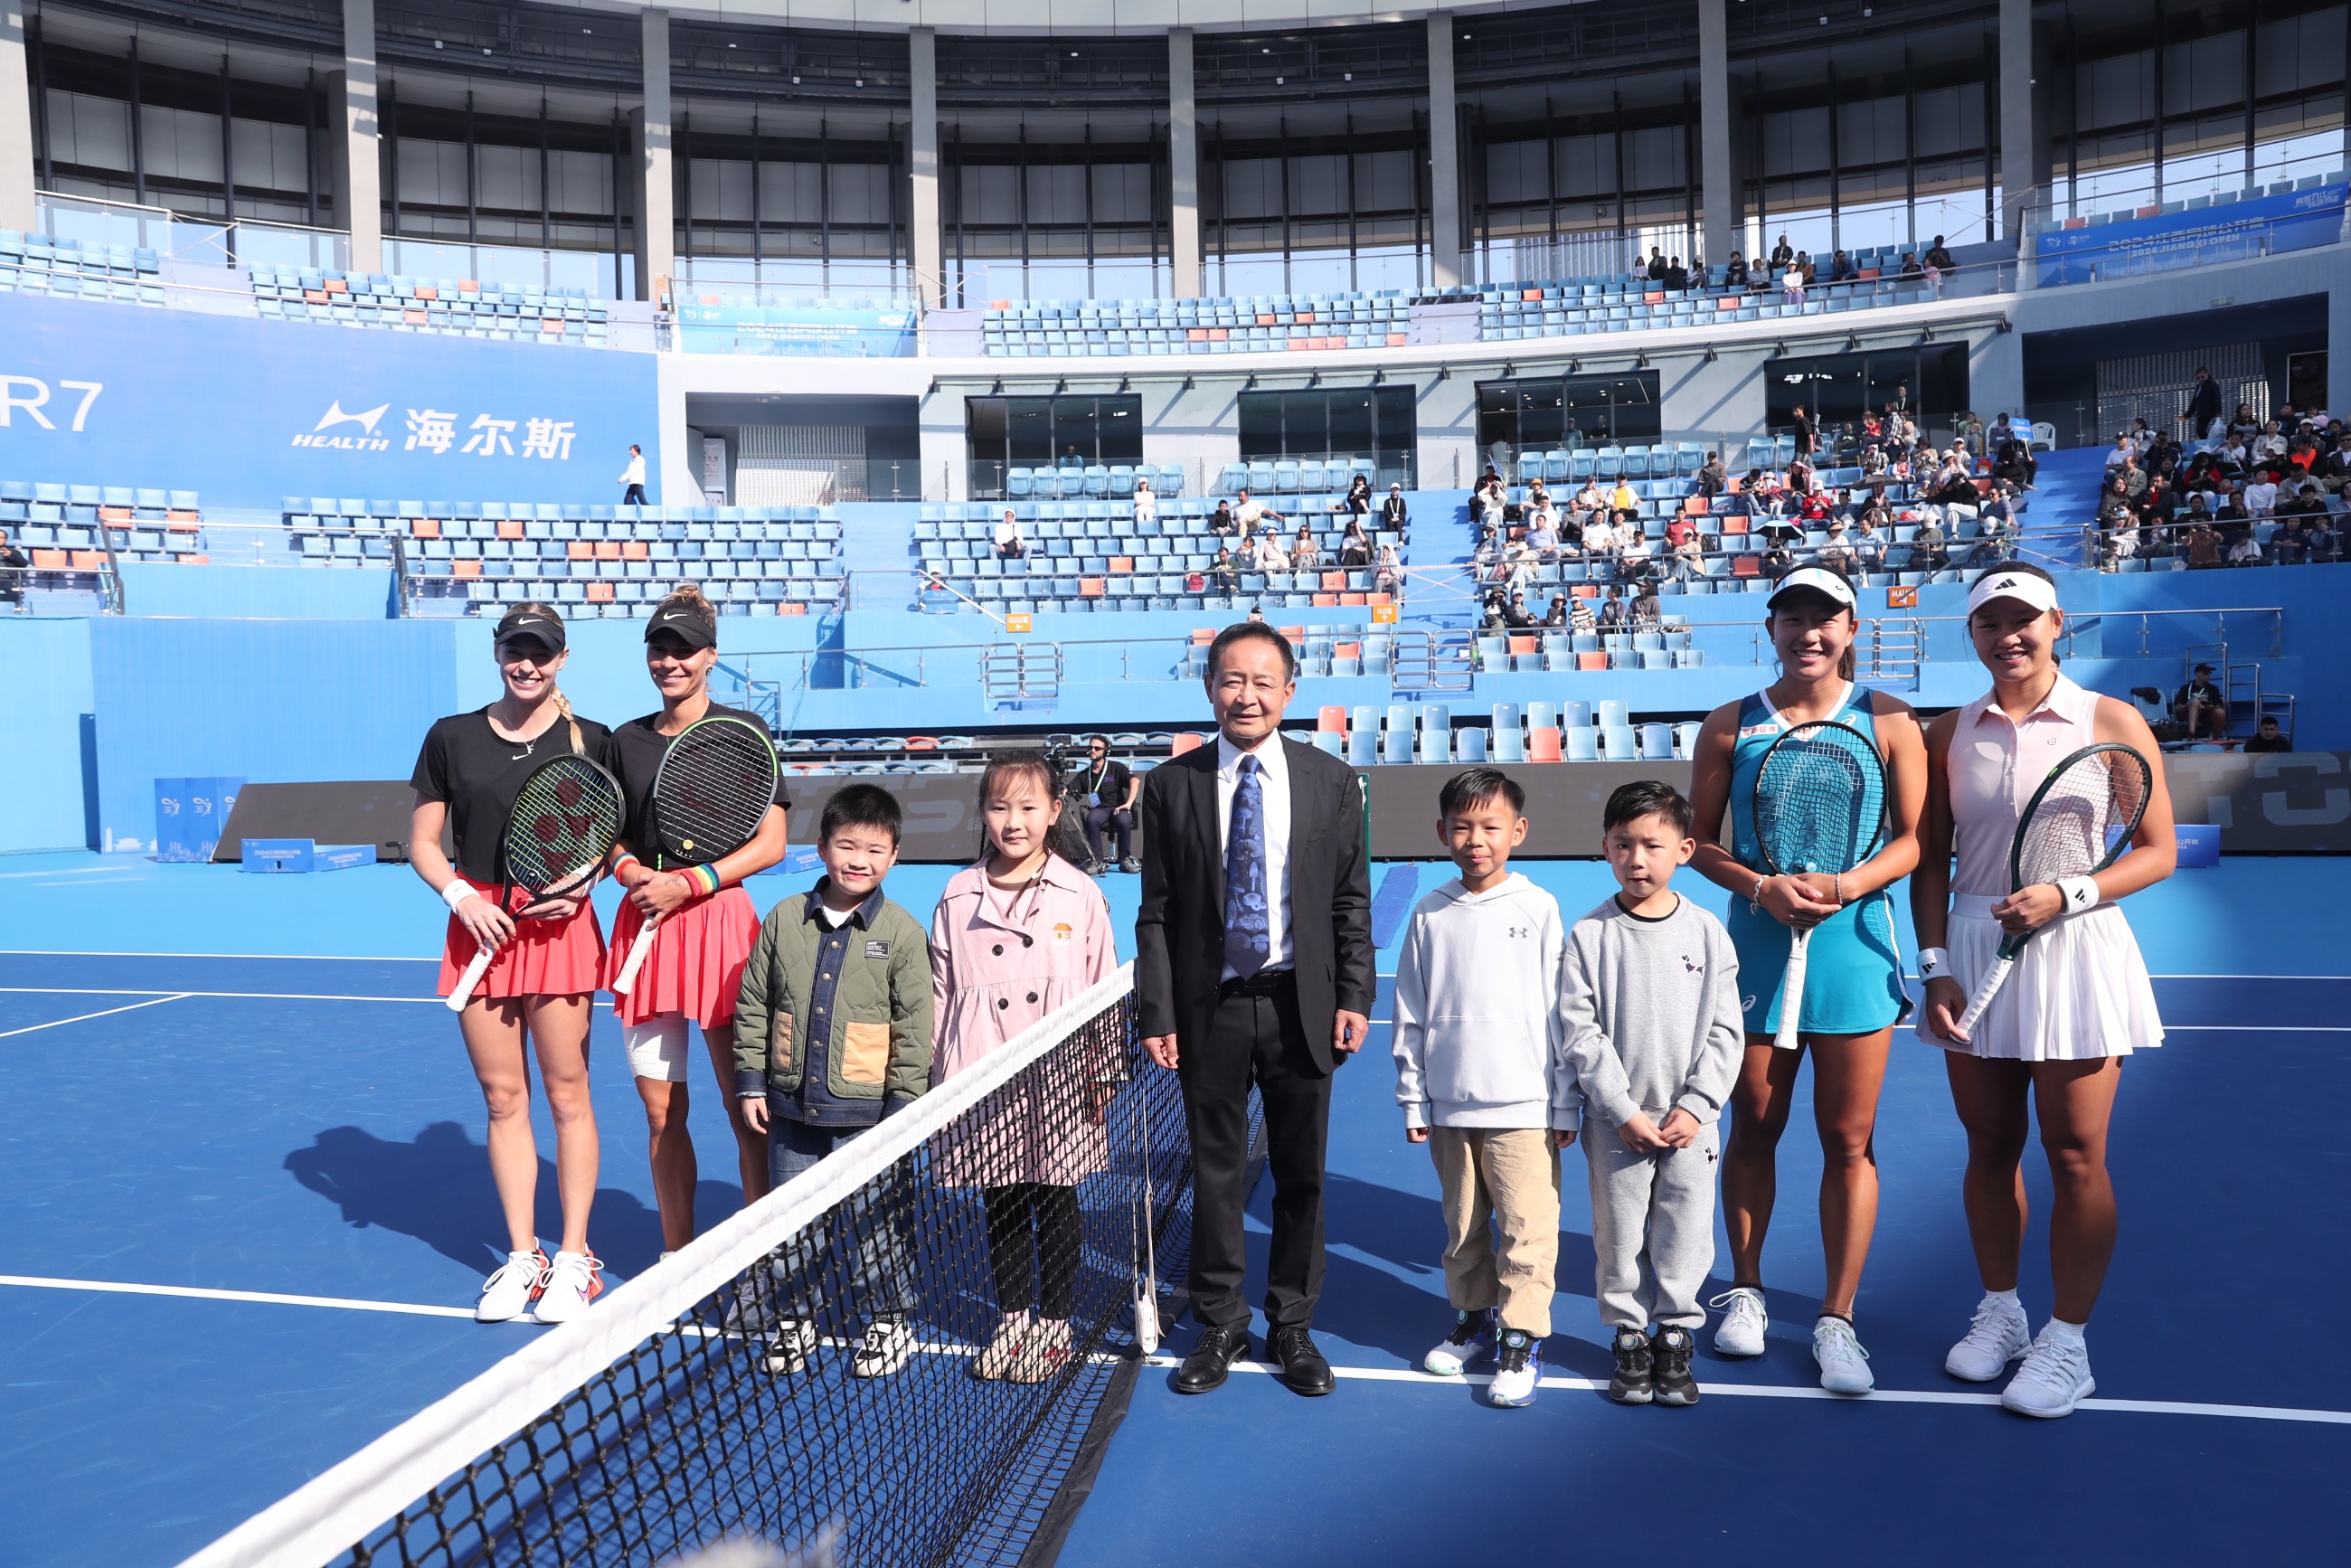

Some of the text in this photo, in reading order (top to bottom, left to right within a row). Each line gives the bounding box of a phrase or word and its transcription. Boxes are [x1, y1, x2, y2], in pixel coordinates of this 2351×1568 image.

[2131, 233, 2241, 258] 2024 JIANGXI OPEN
[0, 373, 103, 432] R7
[291, 434, 390, 451] HEALTH
[404, 409, 577, 460] 海尔斯
